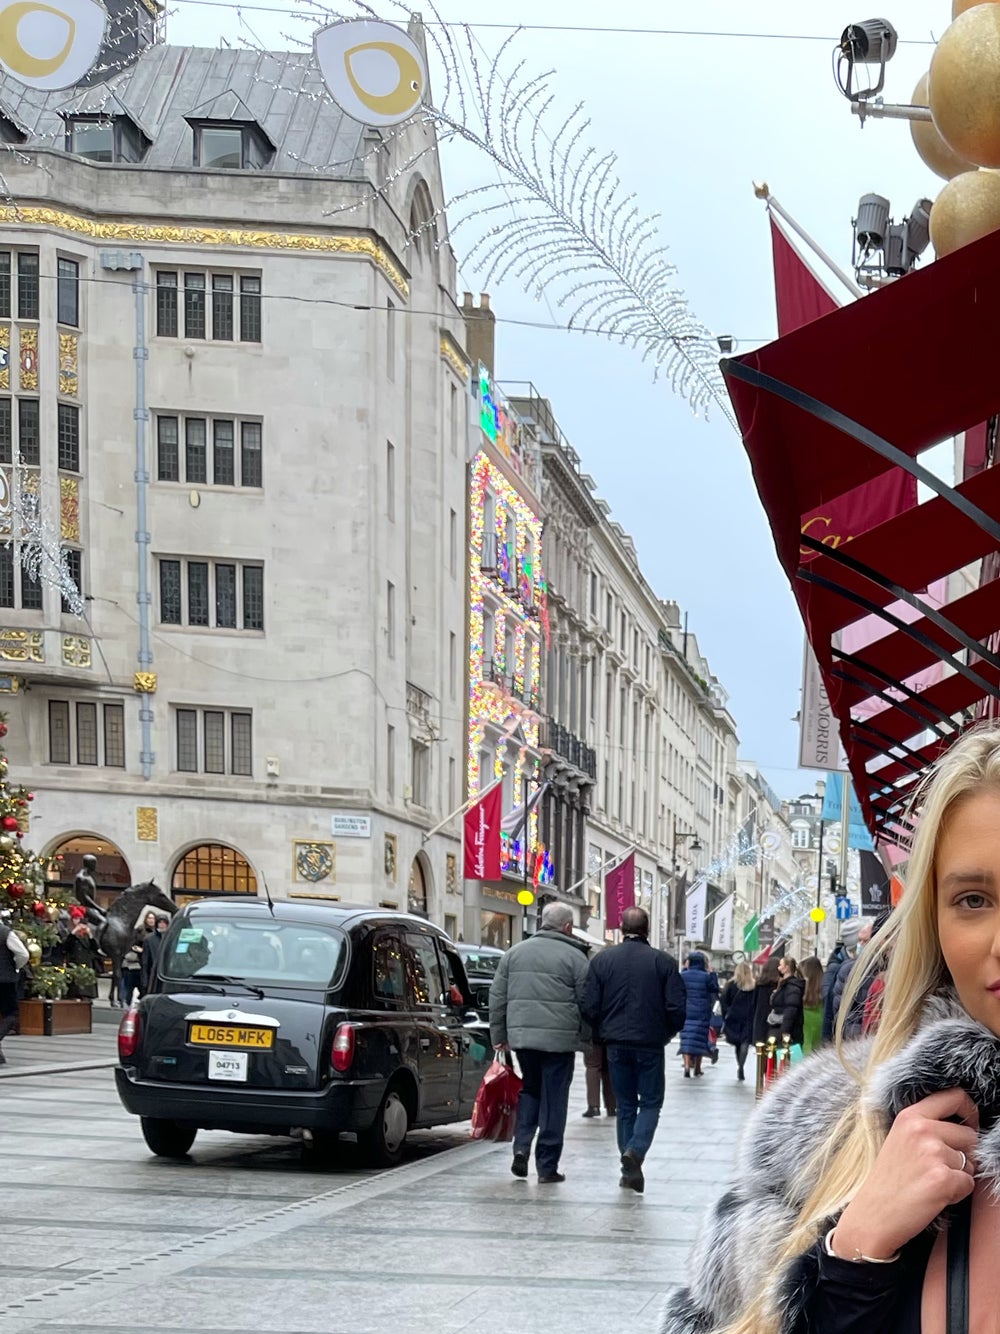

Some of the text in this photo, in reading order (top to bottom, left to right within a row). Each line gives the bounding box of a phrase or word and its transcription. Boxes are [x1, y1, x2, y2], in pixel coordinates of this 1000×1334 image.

[816, 703, 830, 764] MORRIS
[690, 904, 698, 934] PRADA
[197, 1027, 266, 1044] LO65 MFK
[216, 1061, 240, 1070] 04713
